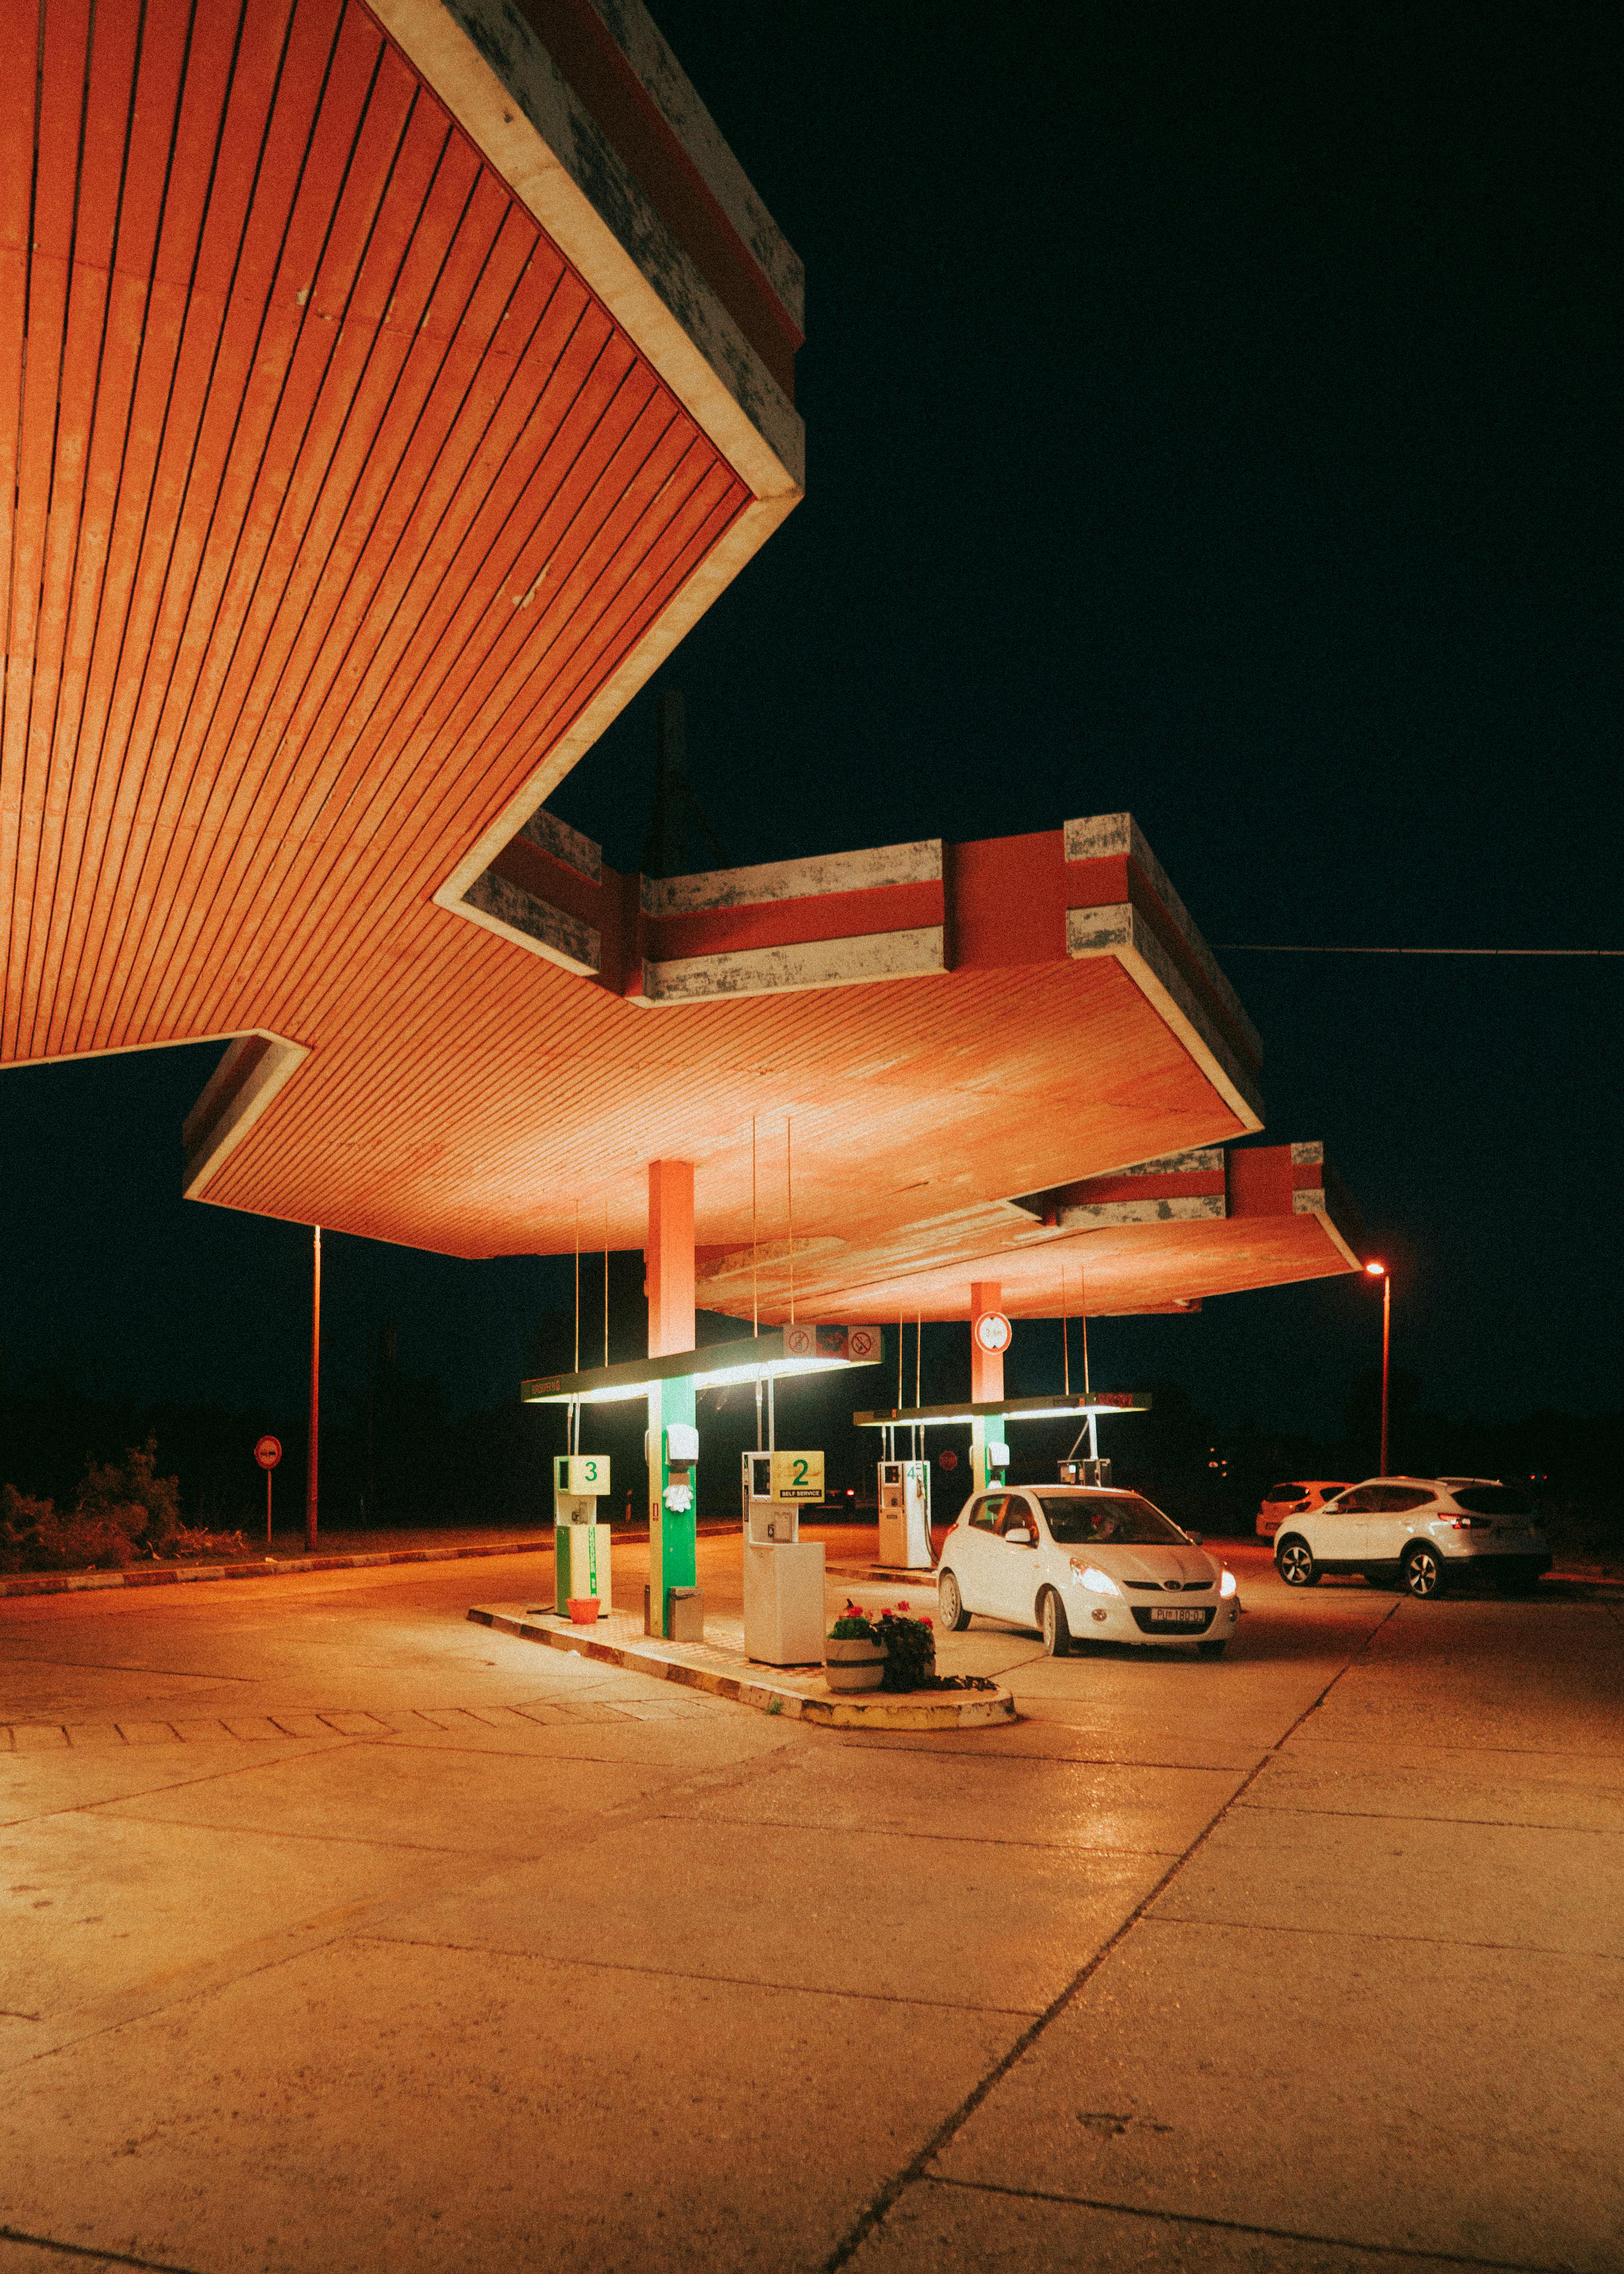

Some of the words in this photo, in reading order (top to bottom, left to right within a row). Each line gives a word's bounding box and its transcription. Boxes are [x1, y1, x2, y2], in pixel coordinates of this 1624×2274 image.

[585, 1461, 597, 1482] 3
[792, 1459, 808, 1486] 2
[907, 1466, 916, 1479] 4
[1157, 1609, 1168, 1620] PU
